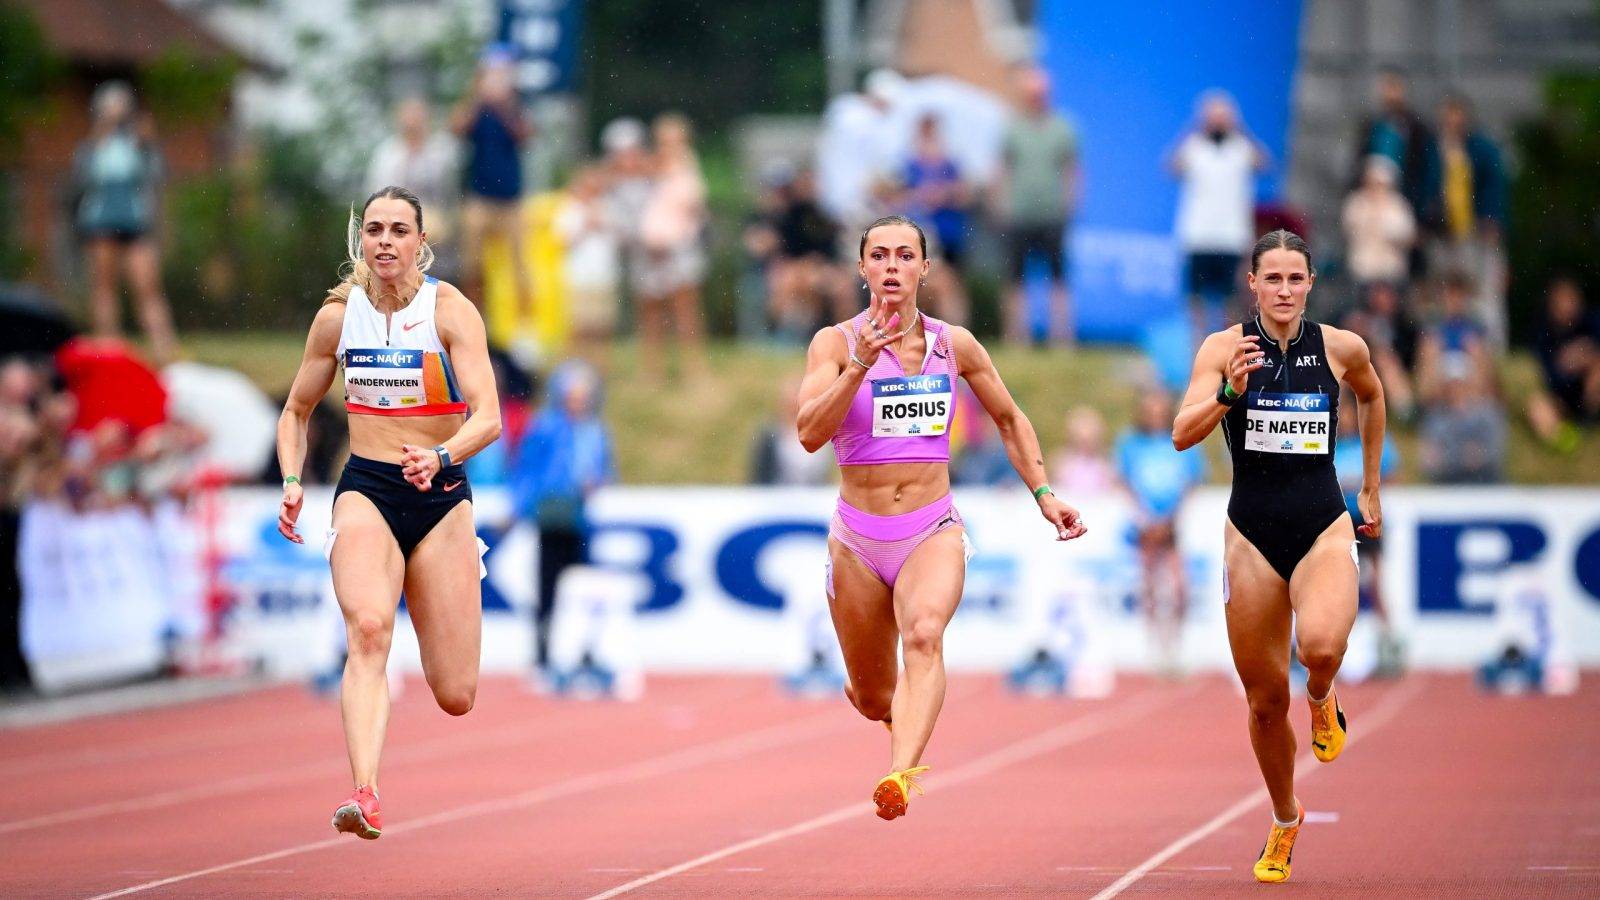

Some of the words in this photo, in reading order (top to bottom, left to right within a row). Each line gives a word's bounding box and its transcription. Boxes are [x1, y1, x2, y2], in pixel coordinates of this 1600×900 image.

[1295, 355, 1321, 367] ART.
[881, 400, 946, 420] ROSIUS
[1246, 419, 1264, 433] DE
[1268, 421, 1327, 435] NAEYER
